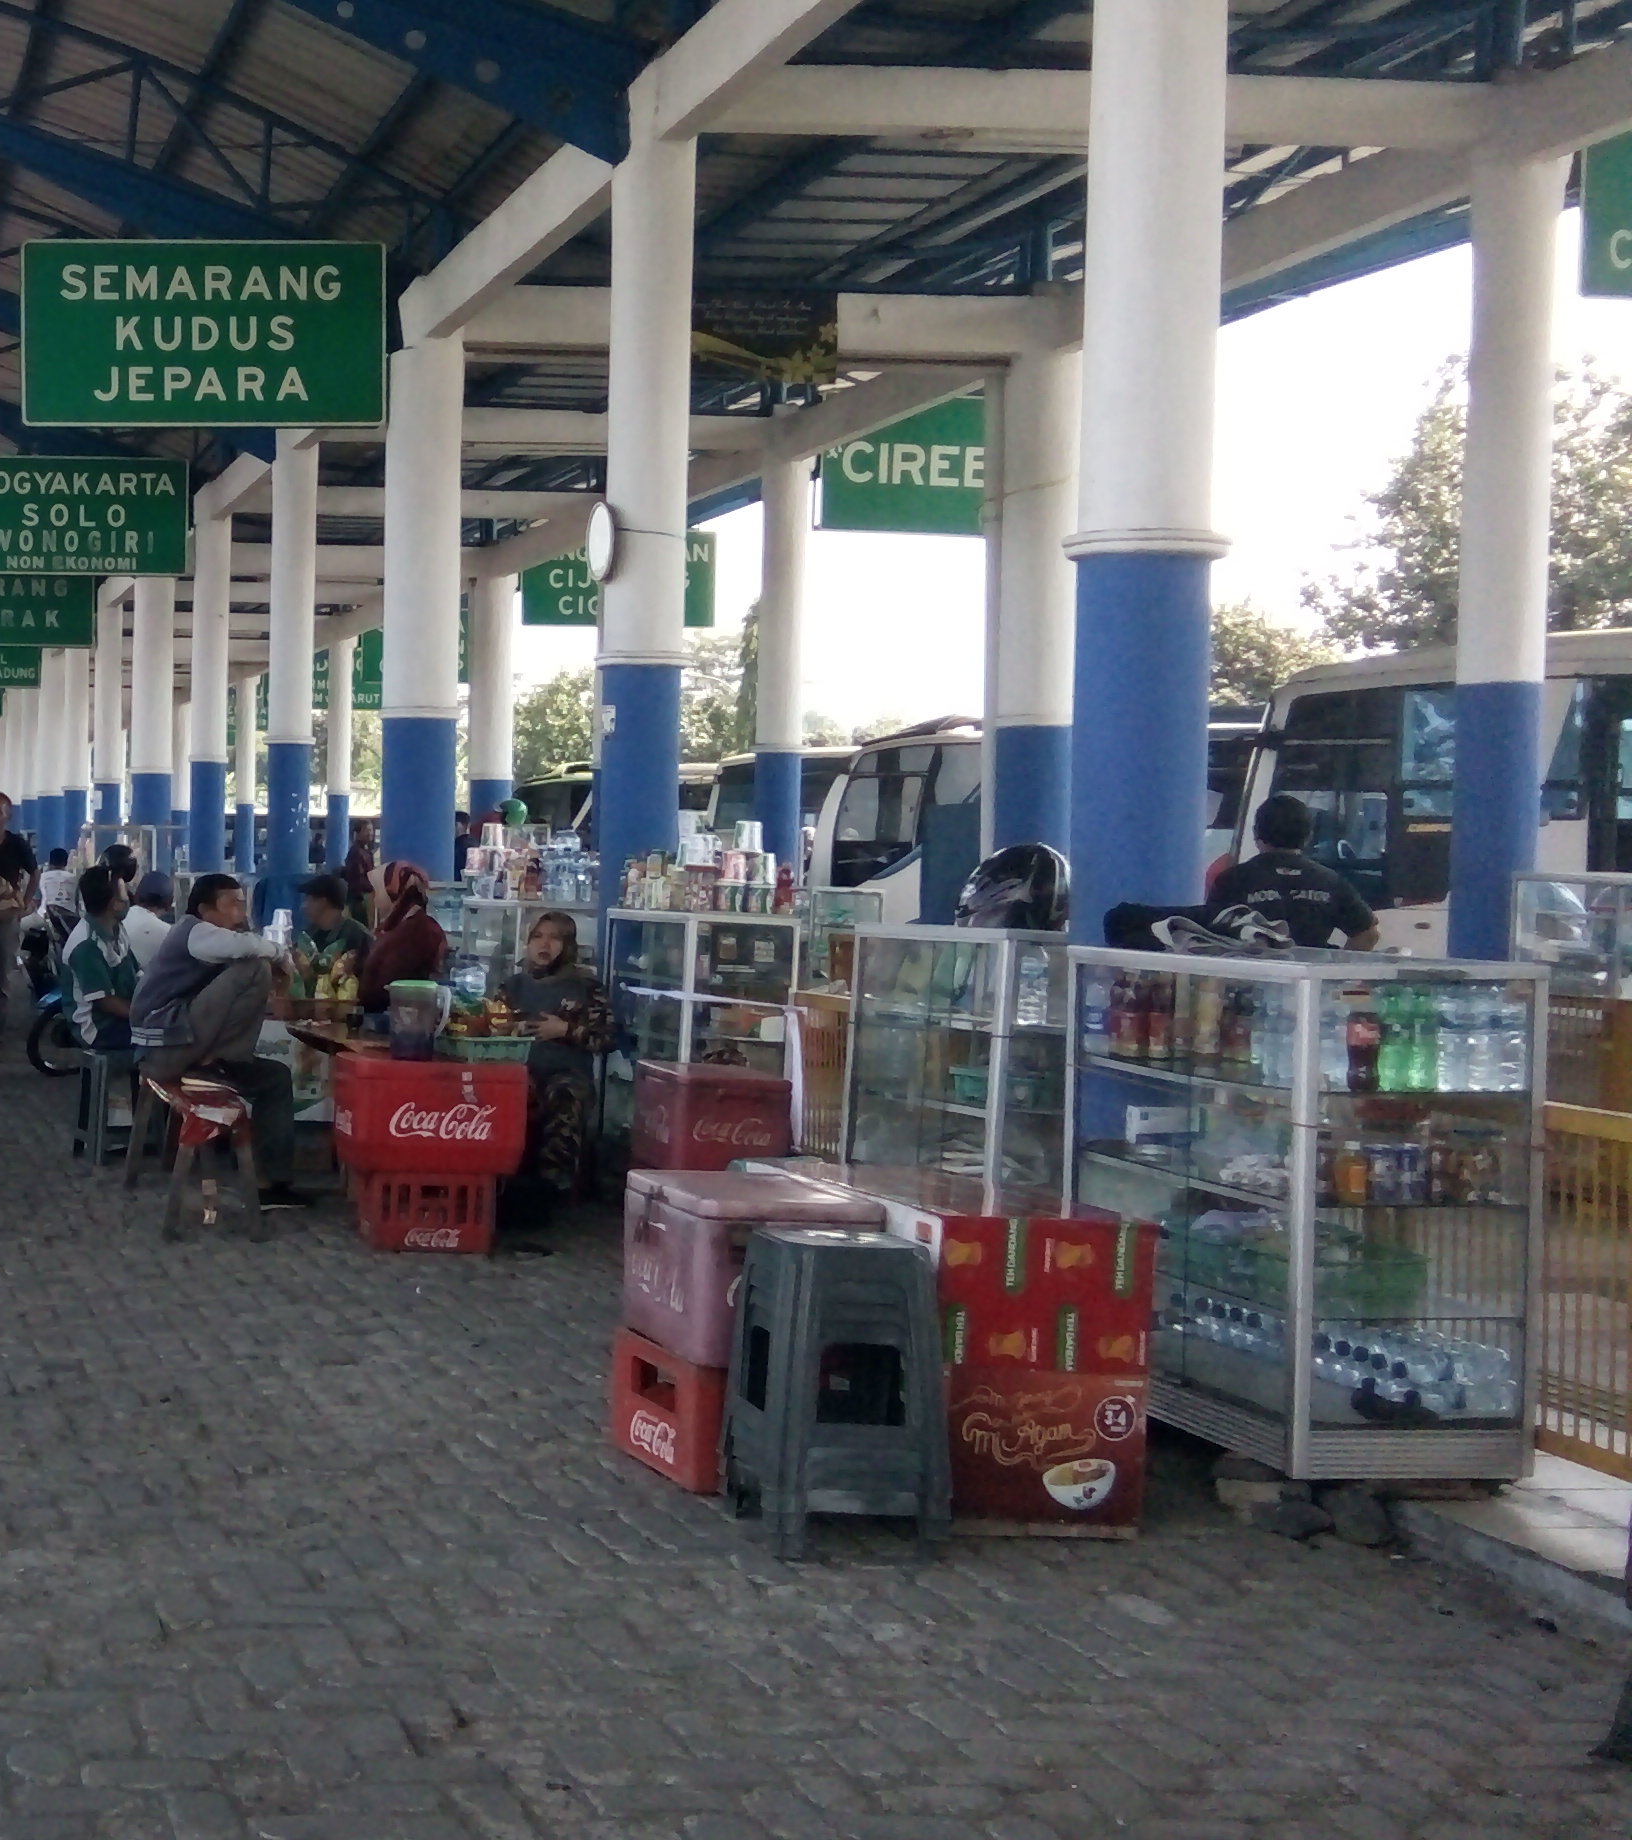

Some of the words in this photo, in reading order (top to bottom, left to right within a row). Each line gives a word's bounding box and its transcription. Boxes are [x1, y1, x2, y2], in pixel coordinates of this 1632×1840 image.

[60, 264, 342, 301] SEMARANG
[115, 315, 295, 351] KUDUS
[93, 366, 309, 402] JEPARA
[21, 502, 126, 528] SOLO
[6, 555, 45, 570] NON
[52, 555, 137, 571] EKONOMI
